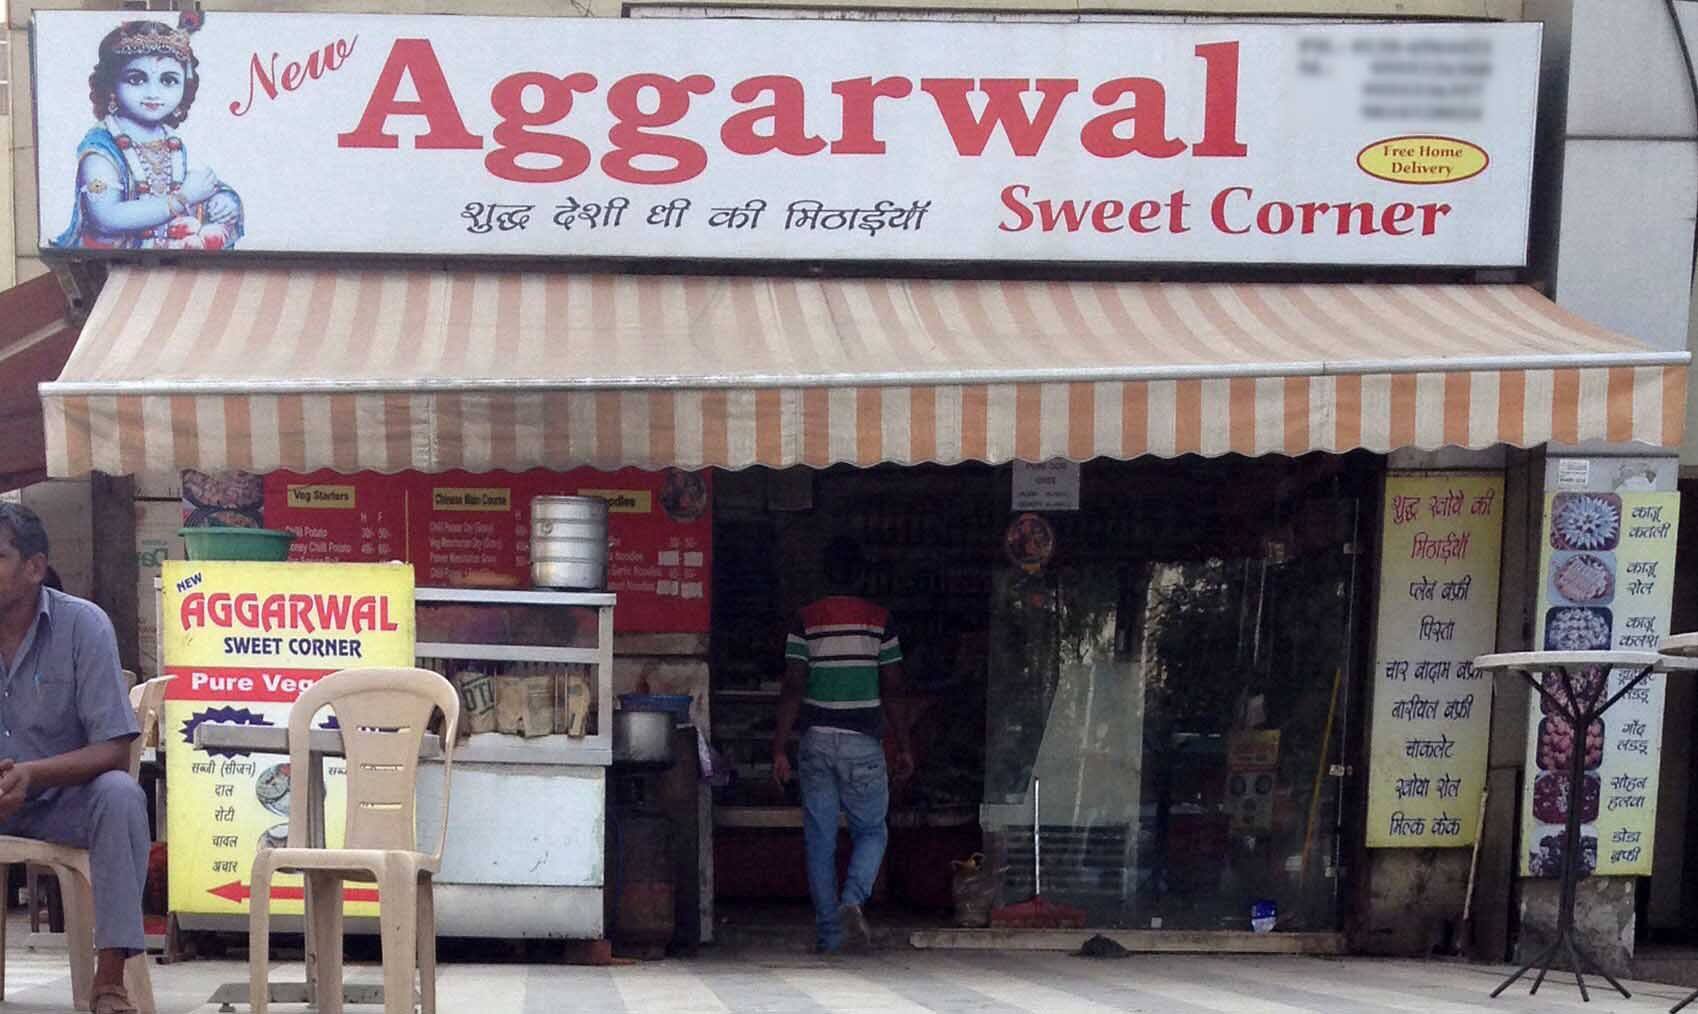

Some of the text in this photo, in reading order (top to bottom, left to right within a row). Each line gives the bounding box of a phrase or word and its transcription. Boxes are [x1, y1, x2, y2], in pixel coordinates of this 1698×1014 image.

[228, 33, 1248, 184] New Aggarwal
[1383, 145, 1464, 158] Free Home
[1391, 161, 1455, 178] Delivery
[460, 201, 536, 234] शुद्ध
[552, 197, 631, 232] देशी
[708, 199, 767, 230] की
[999, 184, 1451, 239] Sweet Corner
[293, 489, 349, 502] Veg Starters
[176, 572, 203, 592] NEW
[180, 592, 398, 634] AGGARWAL
[223, 637, 363, 658] SWEET CORNER
[191, 672, 254, 692] Pure
[214, 783, 234, 798] दाल
[214, 808, 235, 823] रोटी
[212, 834, 239, 848] चावल
[211, 860, 238, 873] अचार
